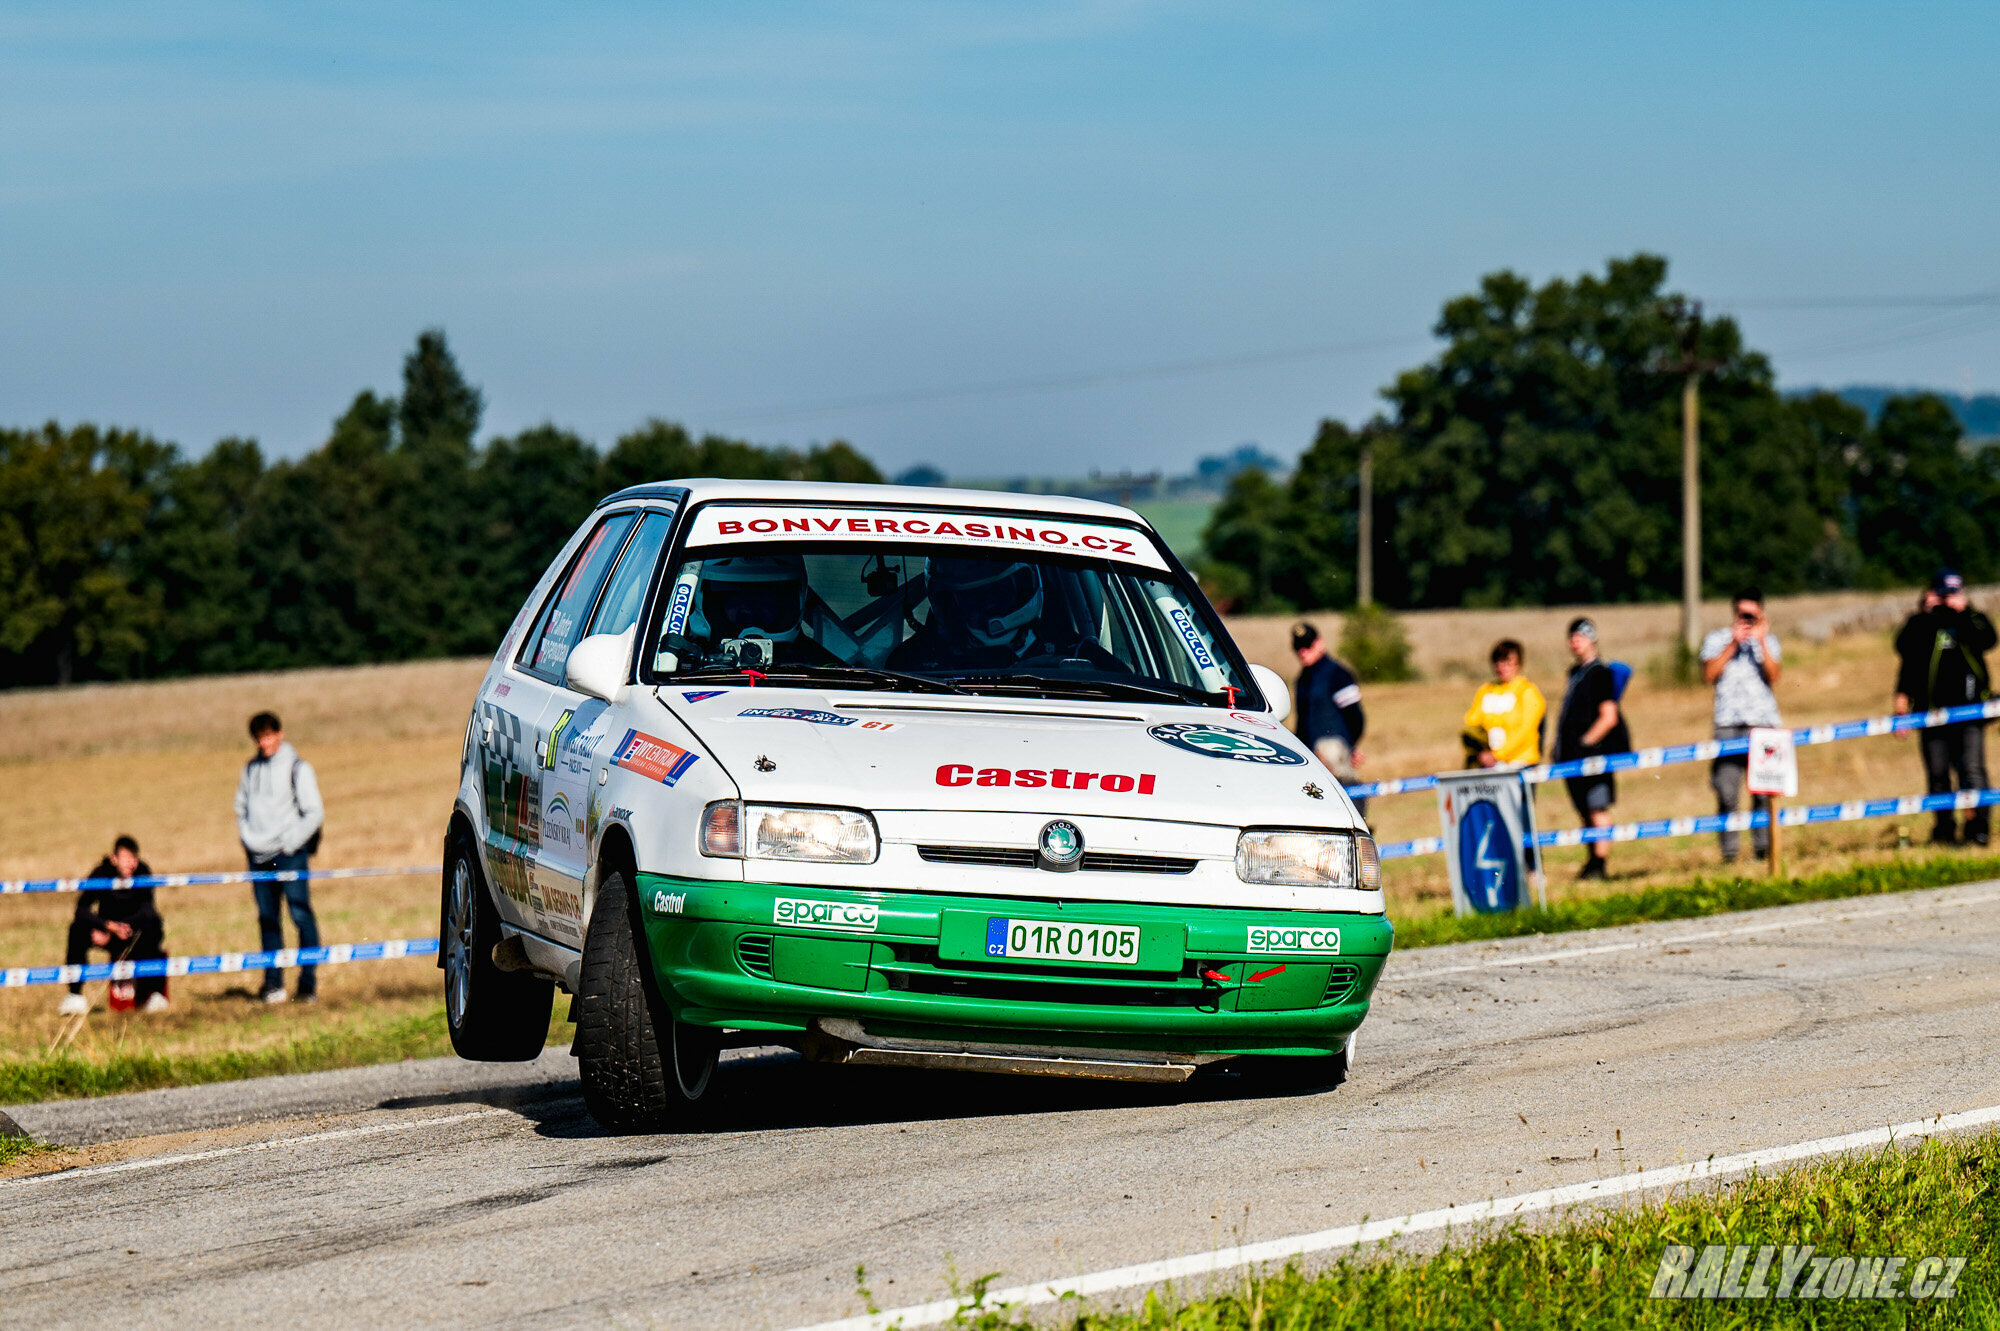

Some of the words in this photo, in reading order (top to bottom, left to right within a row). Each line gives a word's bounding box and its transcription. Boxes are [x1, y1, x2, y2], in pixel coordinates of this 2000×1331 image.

[717, 518, 1136, 556] BONVERCASINO.CZ
[1174, 611, 1212, 665] sparco
[745, 708, 801, 719] INVELT
[804, 714, 855, 725] RALLY
[861, 720, 895, 731] 61
[1233, 754, 1296, 764] AUTO
[935, 763, 1157, 795] Castrol
[654, 890, 686, 914] Castrol
[776, 900, 878, 928] sparco
[988, 944, 1005, 956] CZ
[1010, 924, 1060, 956] 01R
[1069, 928, 1136, 960] 0105
[1249, 927, 1340, 952] sparco
